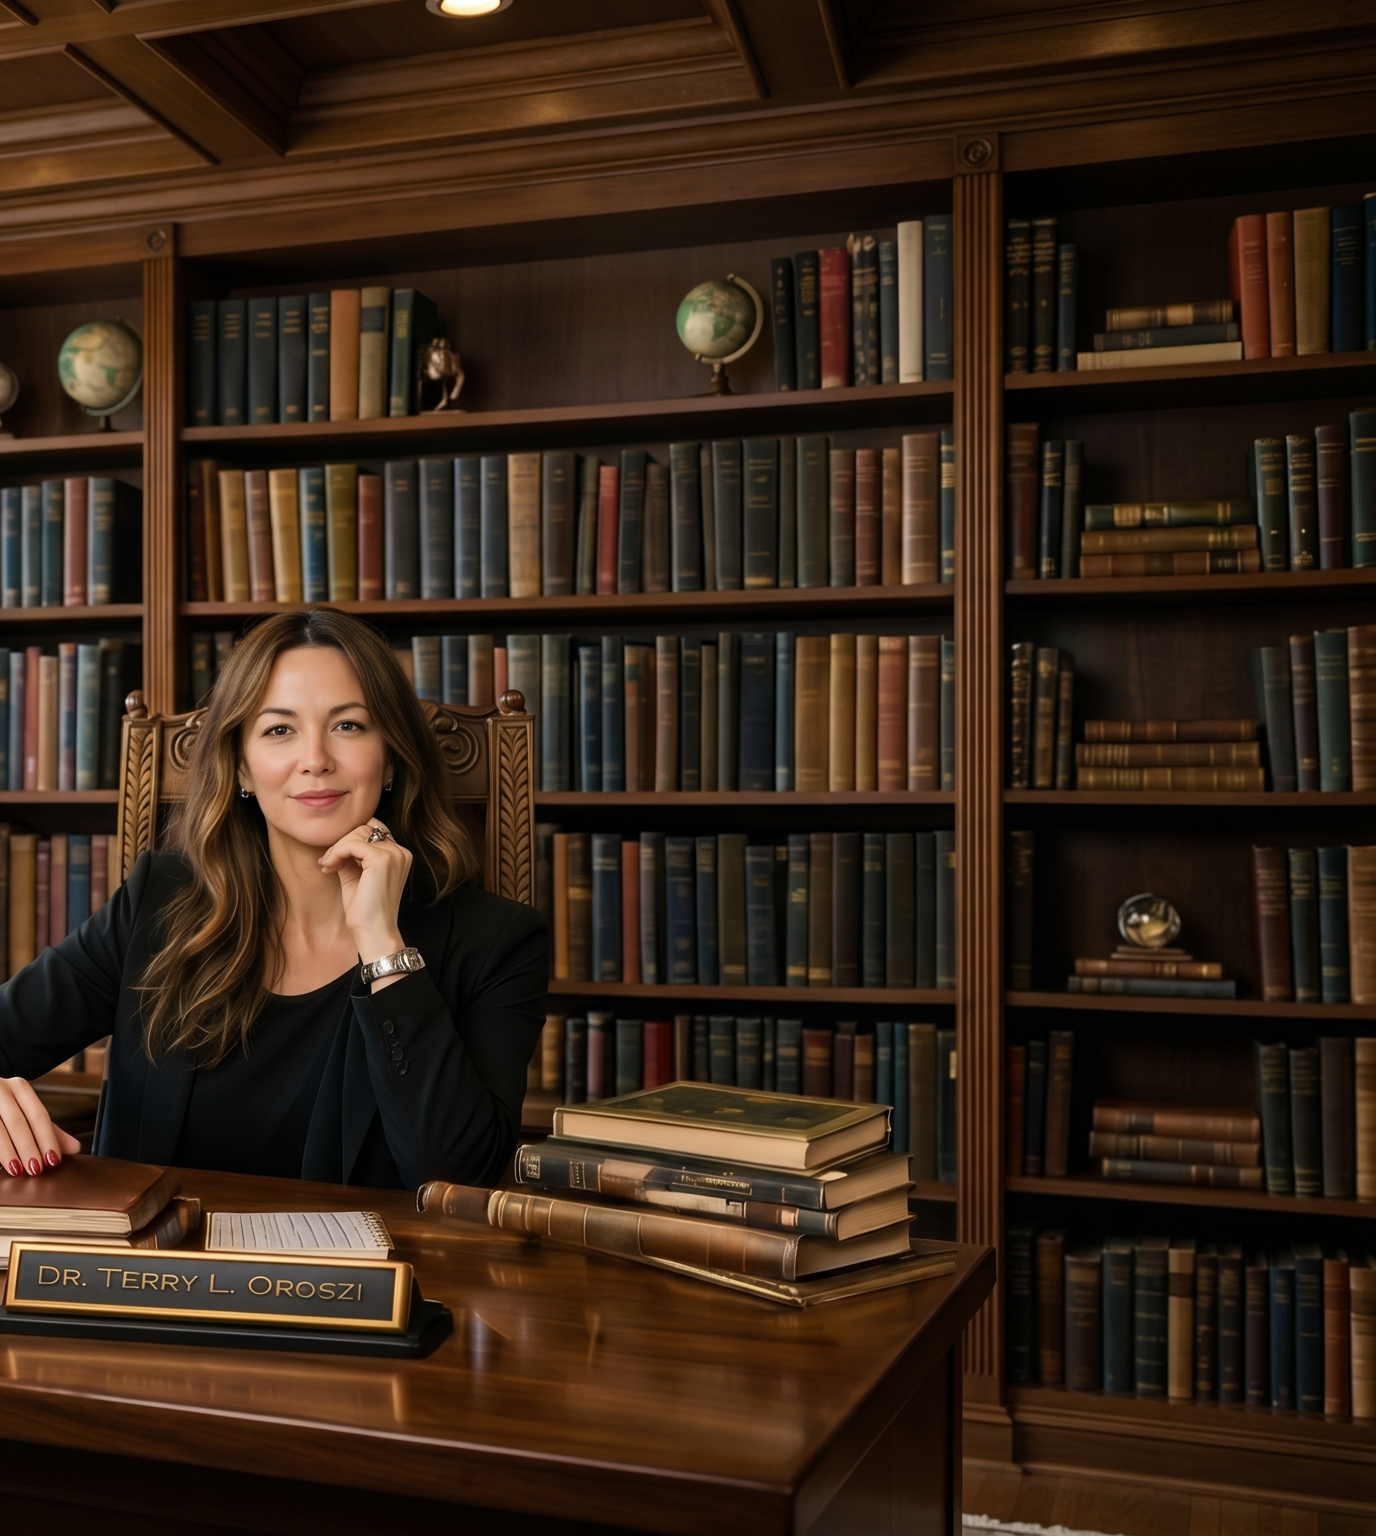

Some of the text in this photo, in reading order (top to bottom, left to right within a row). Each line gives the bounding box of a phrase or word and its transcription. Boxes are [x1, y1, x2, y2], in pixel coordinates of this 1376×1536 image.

[97, 1267, 199, 1292] TERRY
[209, 1273, 235, 1294] L.
[248, 1275, 362, 1301] OROSZI
